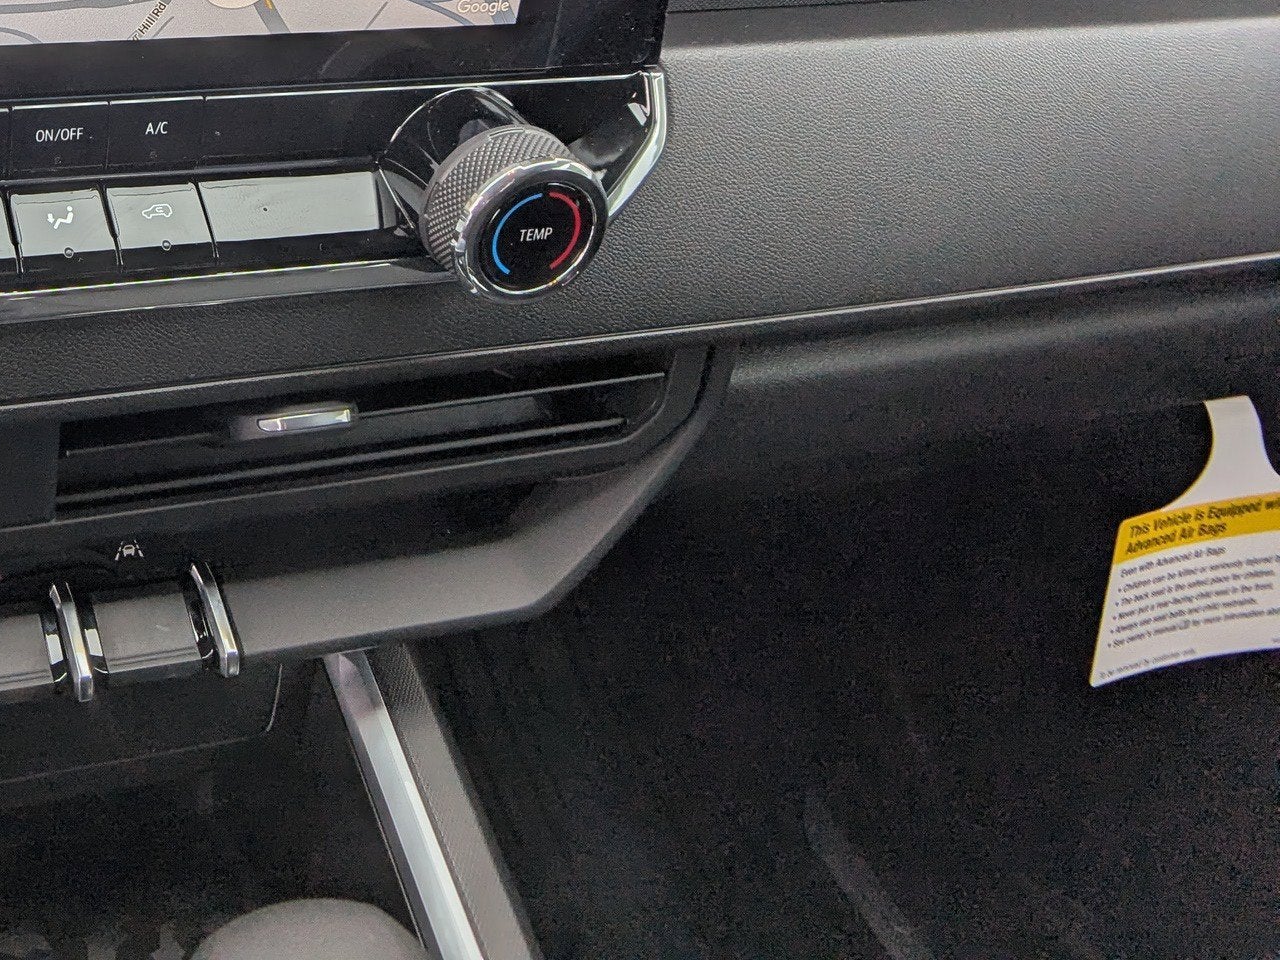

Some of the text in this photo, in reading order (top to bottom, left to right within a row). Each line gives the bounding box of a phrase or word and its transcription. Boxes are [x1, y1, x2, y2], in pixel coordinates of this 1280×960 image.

[137, 1, 167, 36] Hill Rd
[35, 127, 84, 143] ON/OFF
[145, 121, 169, 136] A/C
[520, 227, 554, 242] TEMP
